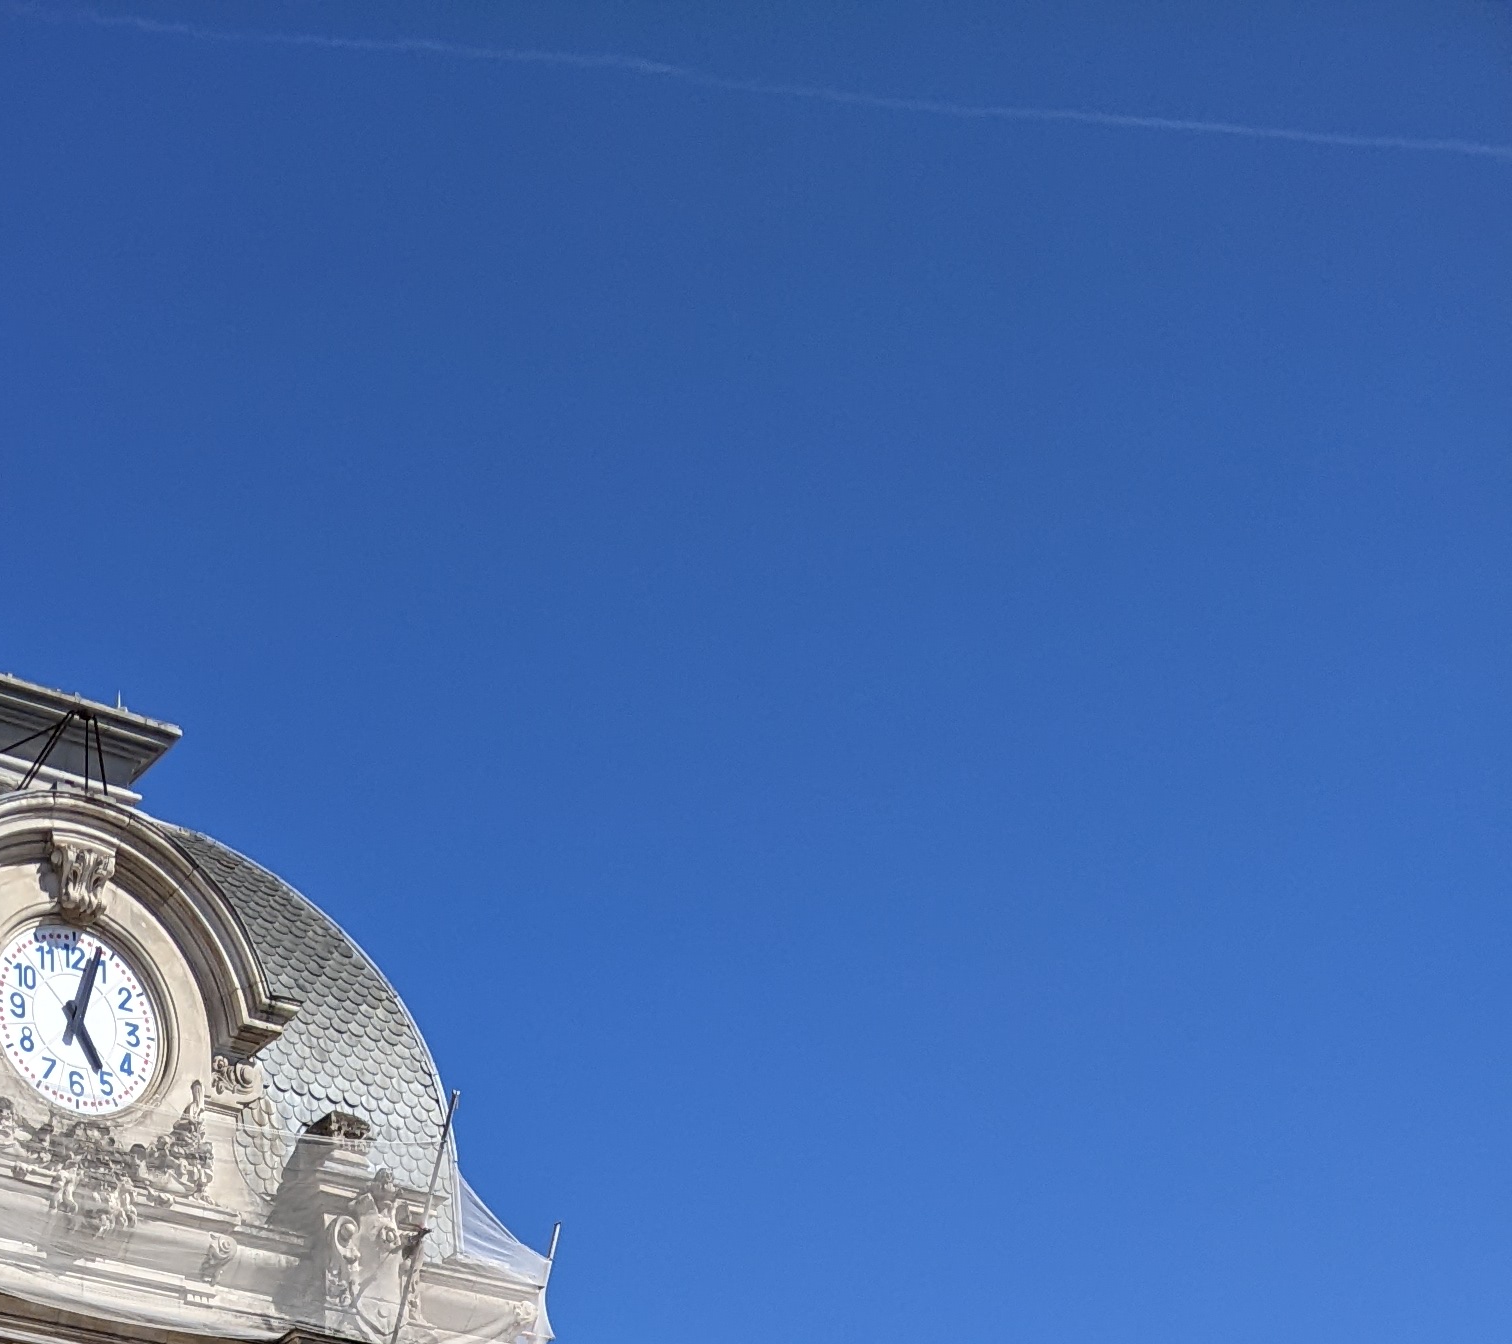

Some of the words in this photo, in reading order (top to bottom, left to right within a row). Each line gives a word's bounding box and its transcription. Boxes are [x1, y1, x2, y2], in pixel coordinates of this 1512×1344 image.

[35, 945, 55, 972] 11
[63, 944, 86, 971] 12
[13, 962, 36, 990] 10
[98, 961, 107, 984] 1
[9, 992, 26, 1019] 9
[117, 987, 133, 1012] 2
[20, 1026, 35, 1052] 8
[125, 1022, 140, 1048] 3
[41, 1056, 56, 1080] 7
[120, 1052, 134, 1077] 4
[68, 1070, 85, 1097] 6
[99, 1070, 114, 1096] 5
